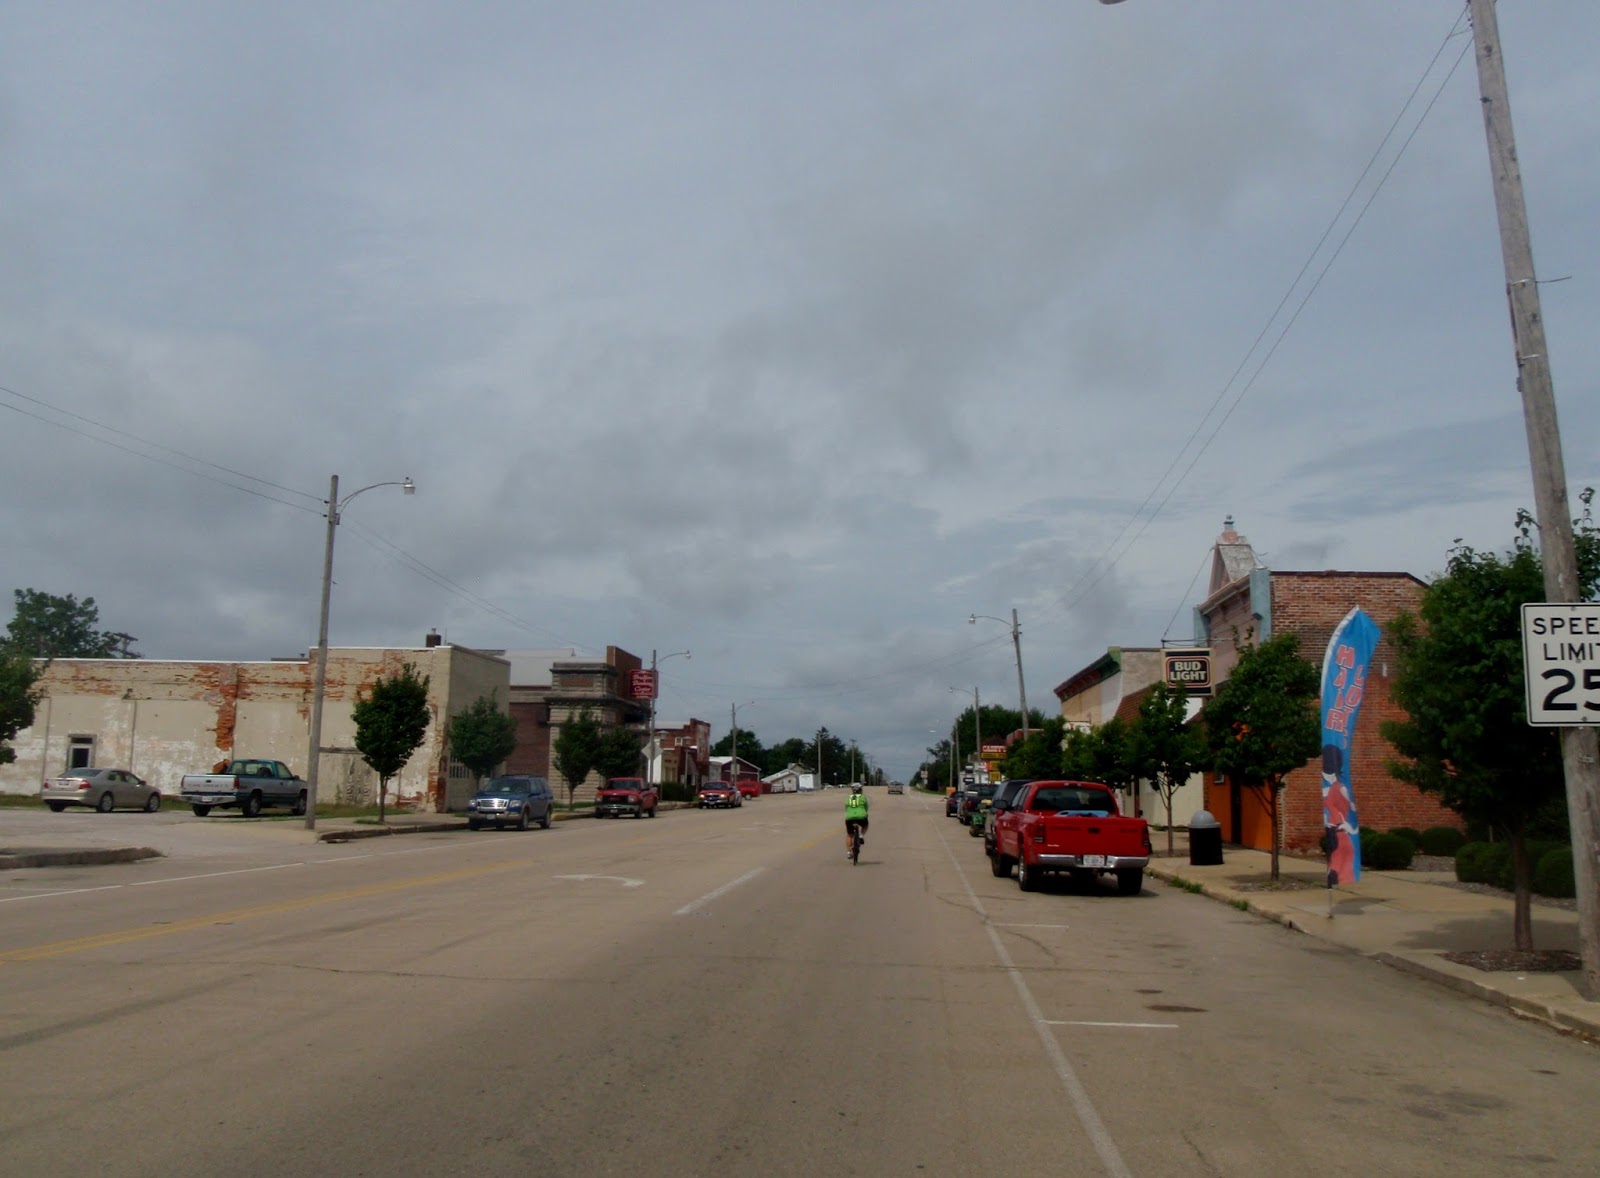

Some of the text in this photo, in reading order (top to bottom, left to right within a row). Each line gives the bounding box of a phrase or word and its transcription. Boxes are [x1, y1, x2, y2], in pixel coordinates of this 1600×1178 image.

[1532, 617, 1600, 636] SPEE
[1174, 661, 1201, 671] BUD
[1170, 671, 1206, 681] LIGHT
[1325, 644, 1355, 732] HAIR
